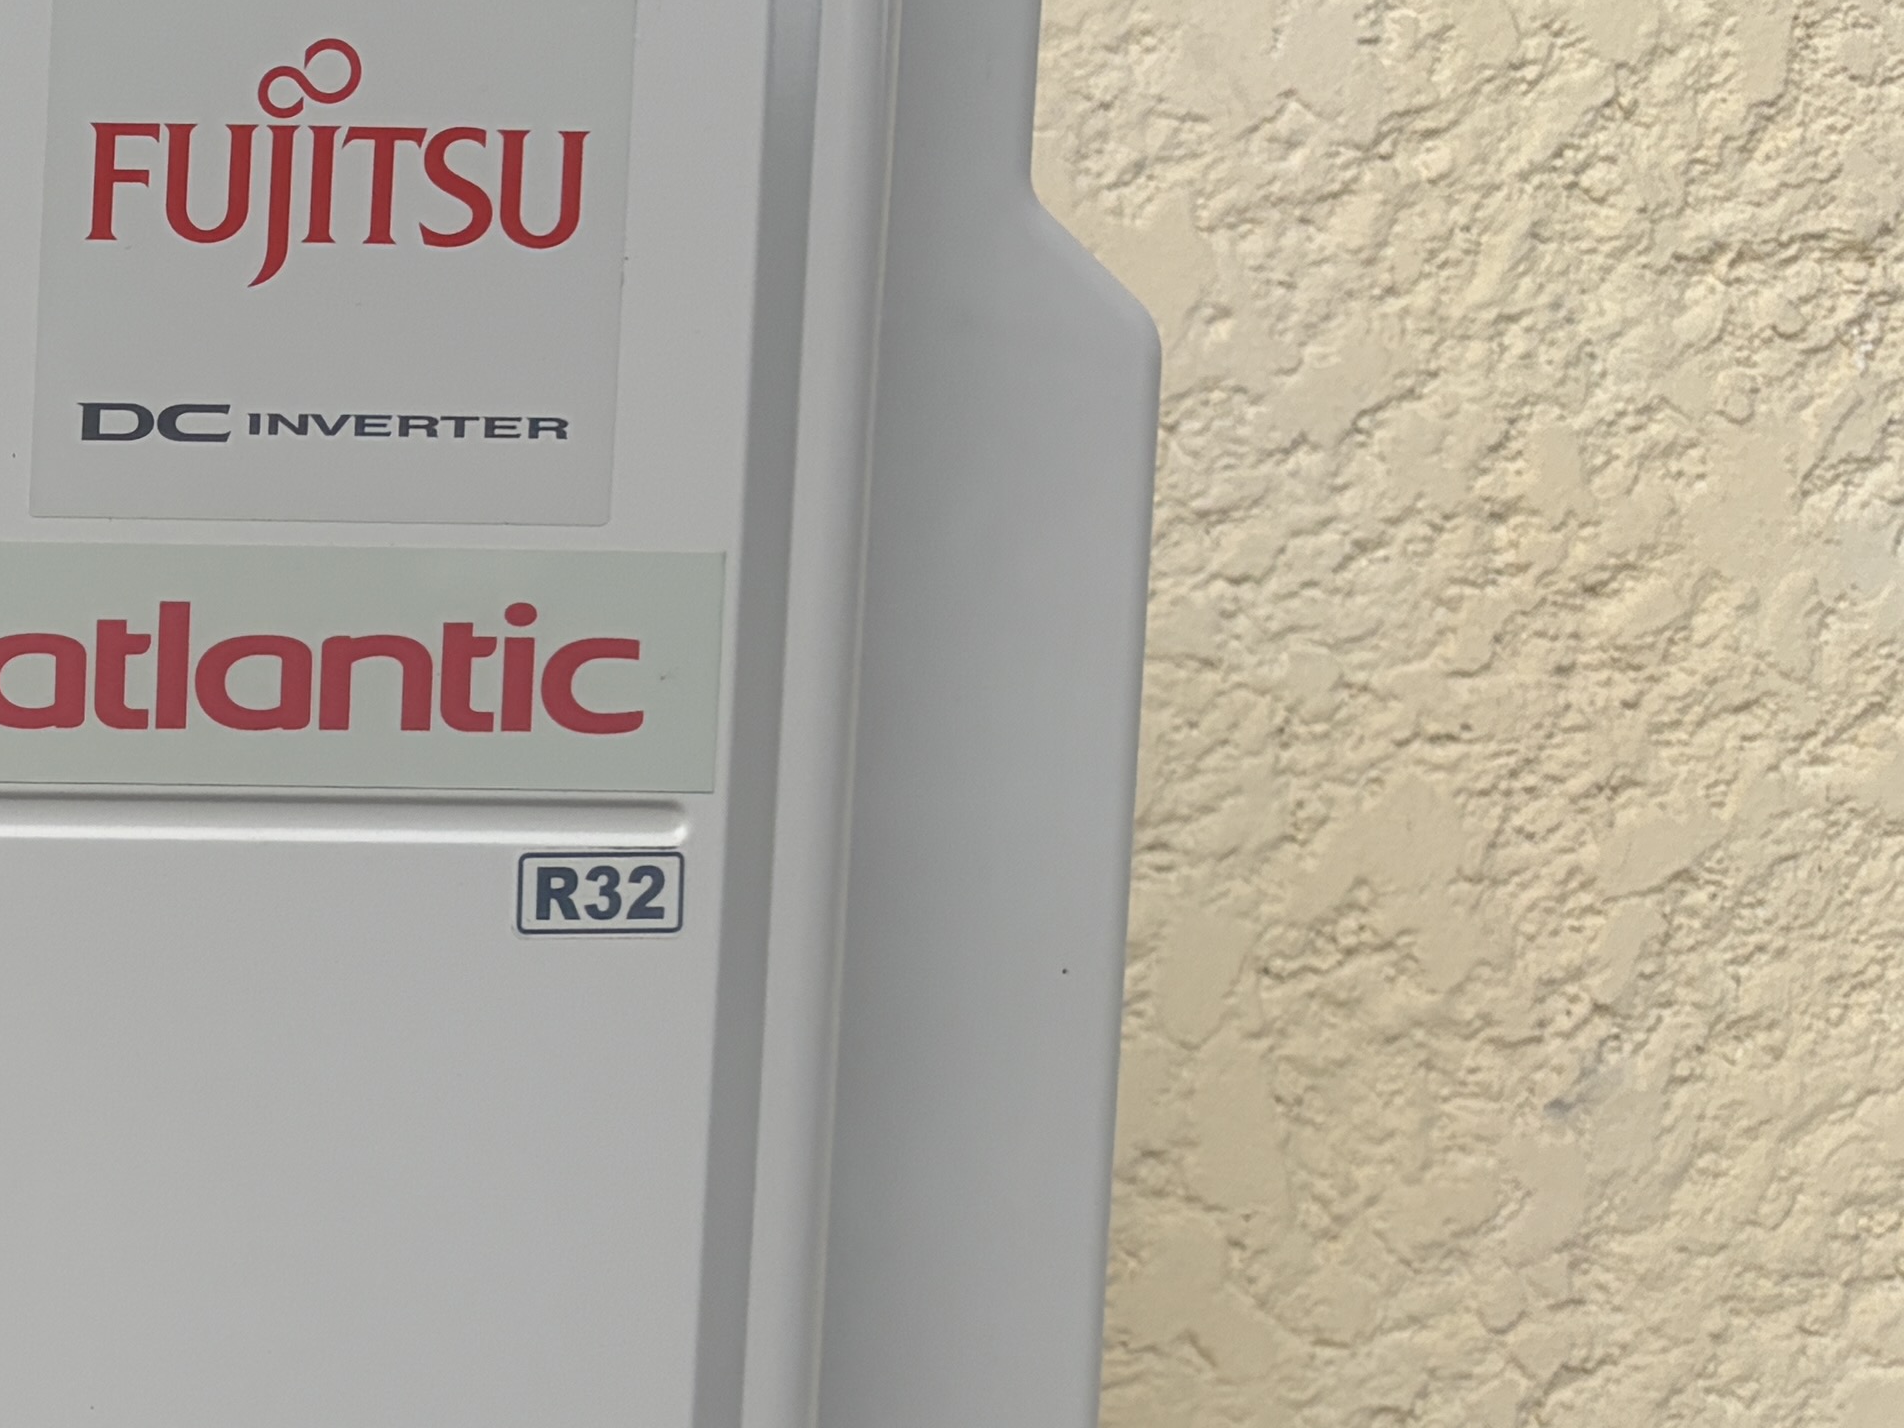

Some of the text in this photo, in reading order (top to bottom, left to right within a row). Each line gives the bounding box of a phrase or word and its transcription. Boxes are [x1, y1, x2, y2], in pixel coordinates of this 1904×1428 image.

[85, 38, 591, 287] FUJITSU
[76, 402, 571, 444] DC INVERTER
[534, 865, 667, 922] R32
